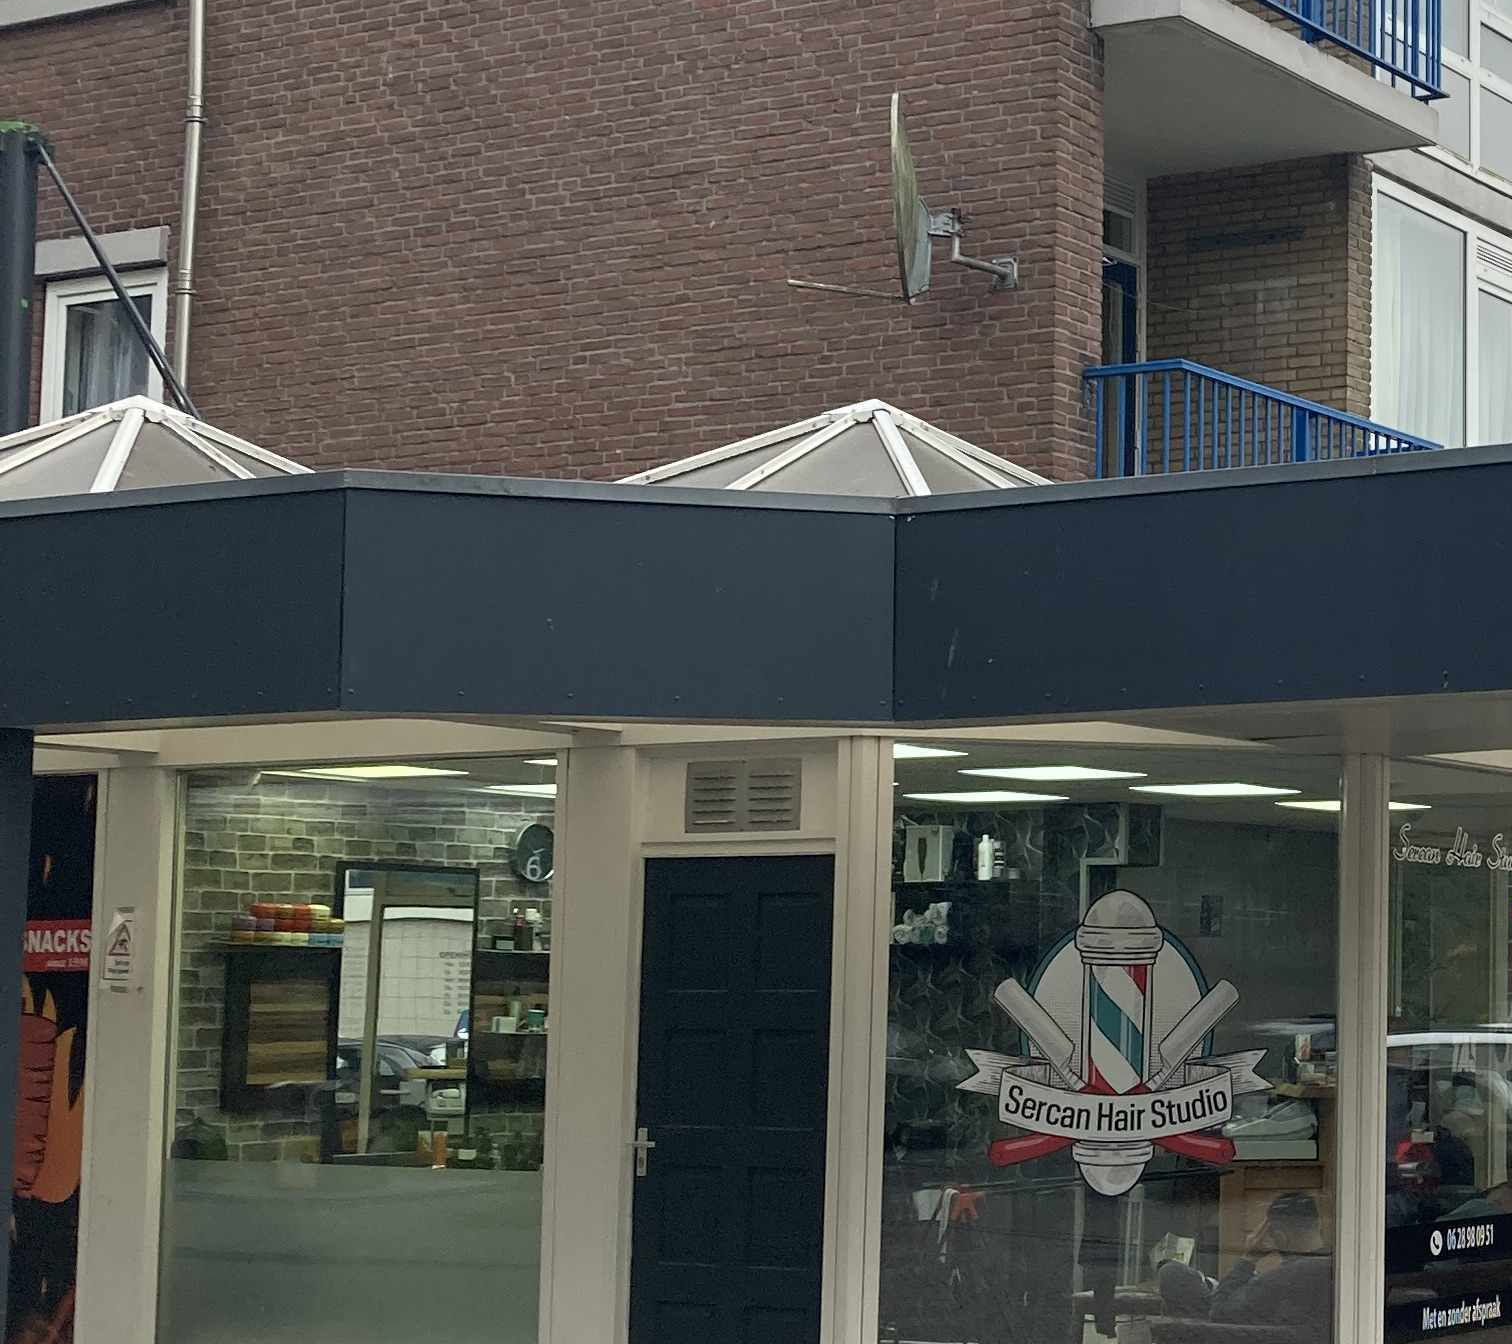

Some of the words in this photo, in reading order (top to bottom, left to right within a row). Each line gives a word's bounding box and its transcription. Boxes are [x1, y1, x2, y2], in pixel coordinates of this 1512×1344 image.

[1393, 823, 1441, 864] Sercan
[1445, 826, 1483, 868] Hair
[1004, 1084, 1090, 1130] Sercan
[1097, 1102, 1145, 1131] Hair
[1151, 1088, 1228, 1129] Studio
[1446, 1228, 1457, 1250] 06
[1457, 1227, 1466, 1249] 28
[1466, 1225, 1476, 1248] 98
[1476, 1224, 1485, 1247] 09
[1485, 1223, 1494, 1246] 51
[1422, 1307, 1437, 1331] Met
[1438, 1312, 1446, 1327] en
[1447, 1300, 1472, 1326] zonder
[1472, 1294, 1501, 1326] afspraak
